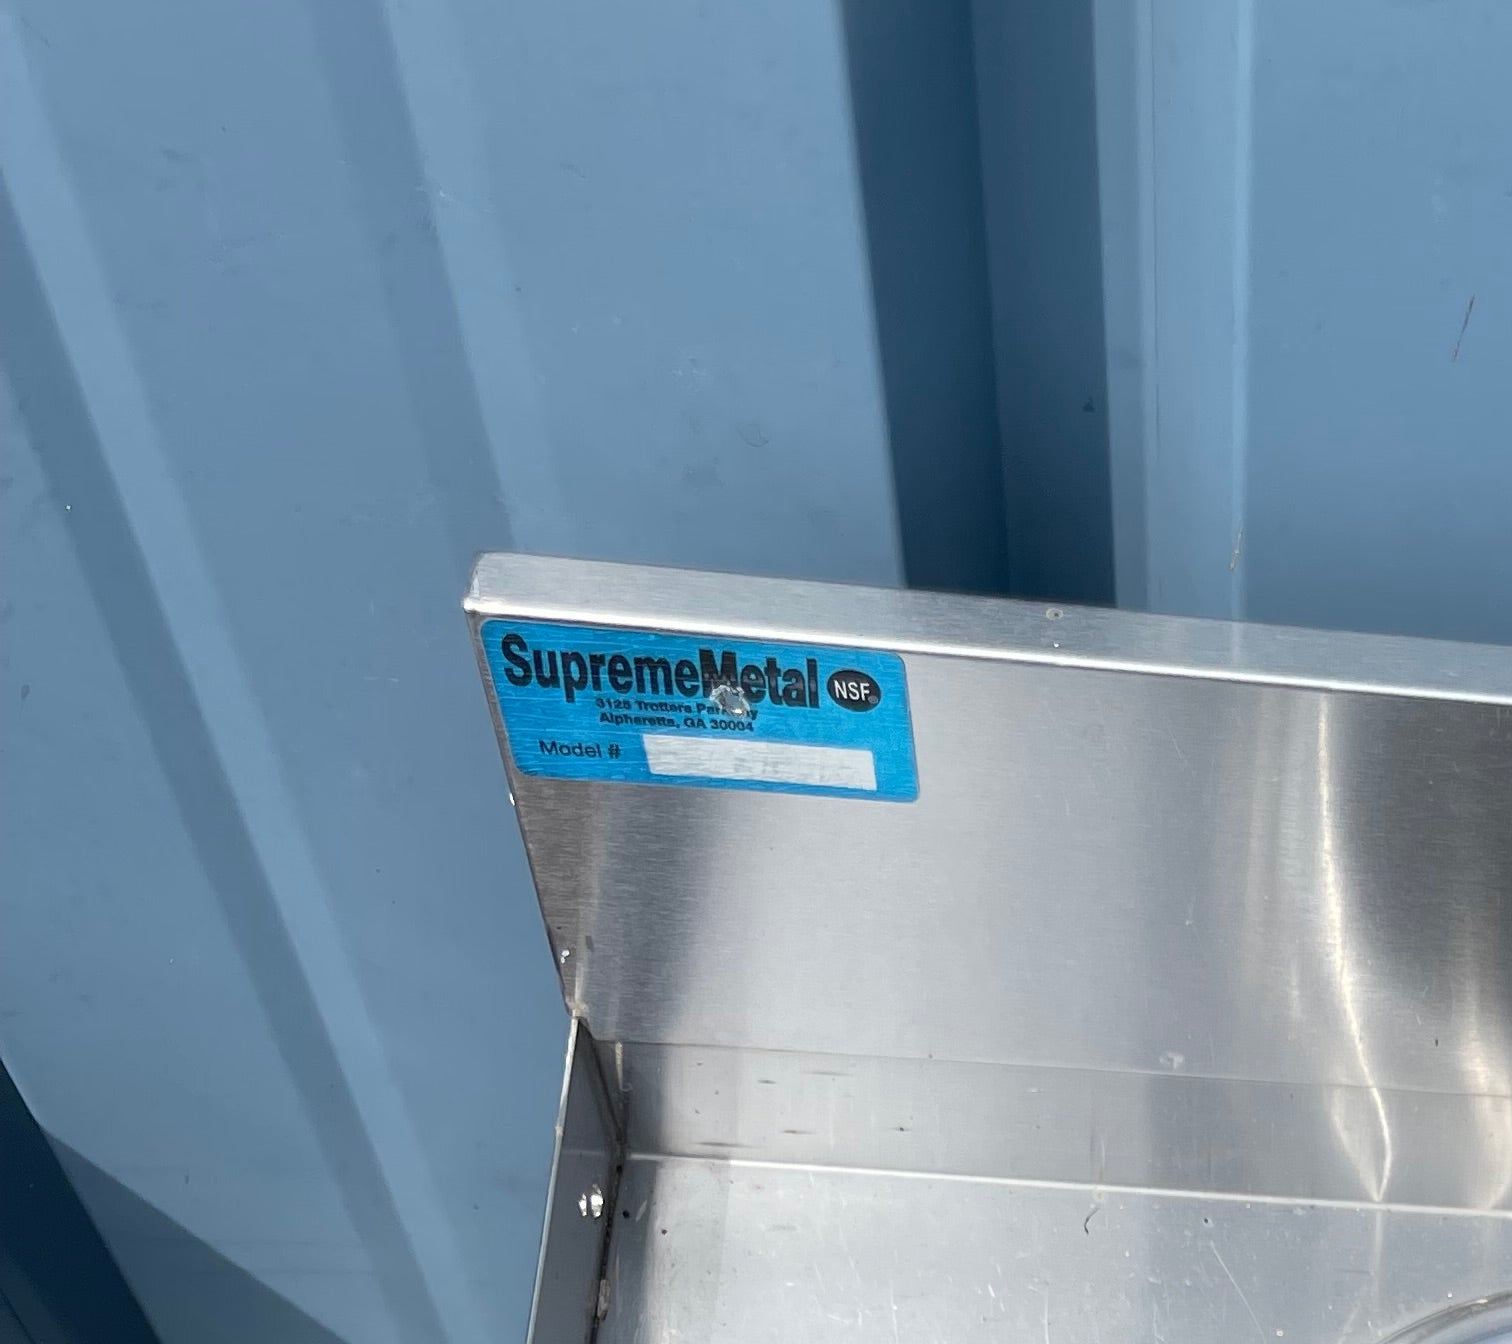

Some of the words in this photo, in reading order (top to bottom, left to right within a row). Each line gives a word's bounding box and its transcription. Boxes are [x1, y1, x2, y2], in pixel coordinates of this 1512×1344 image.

[501, 633, 820, 708] SupremeMetal
[833, 680, 870, 701] NSF
[684, 717, 706, 729] GA
[711, 718, 754, 731] 30004
[539, 740, 601, 758] Model
[607, 743, 622, 760] #
